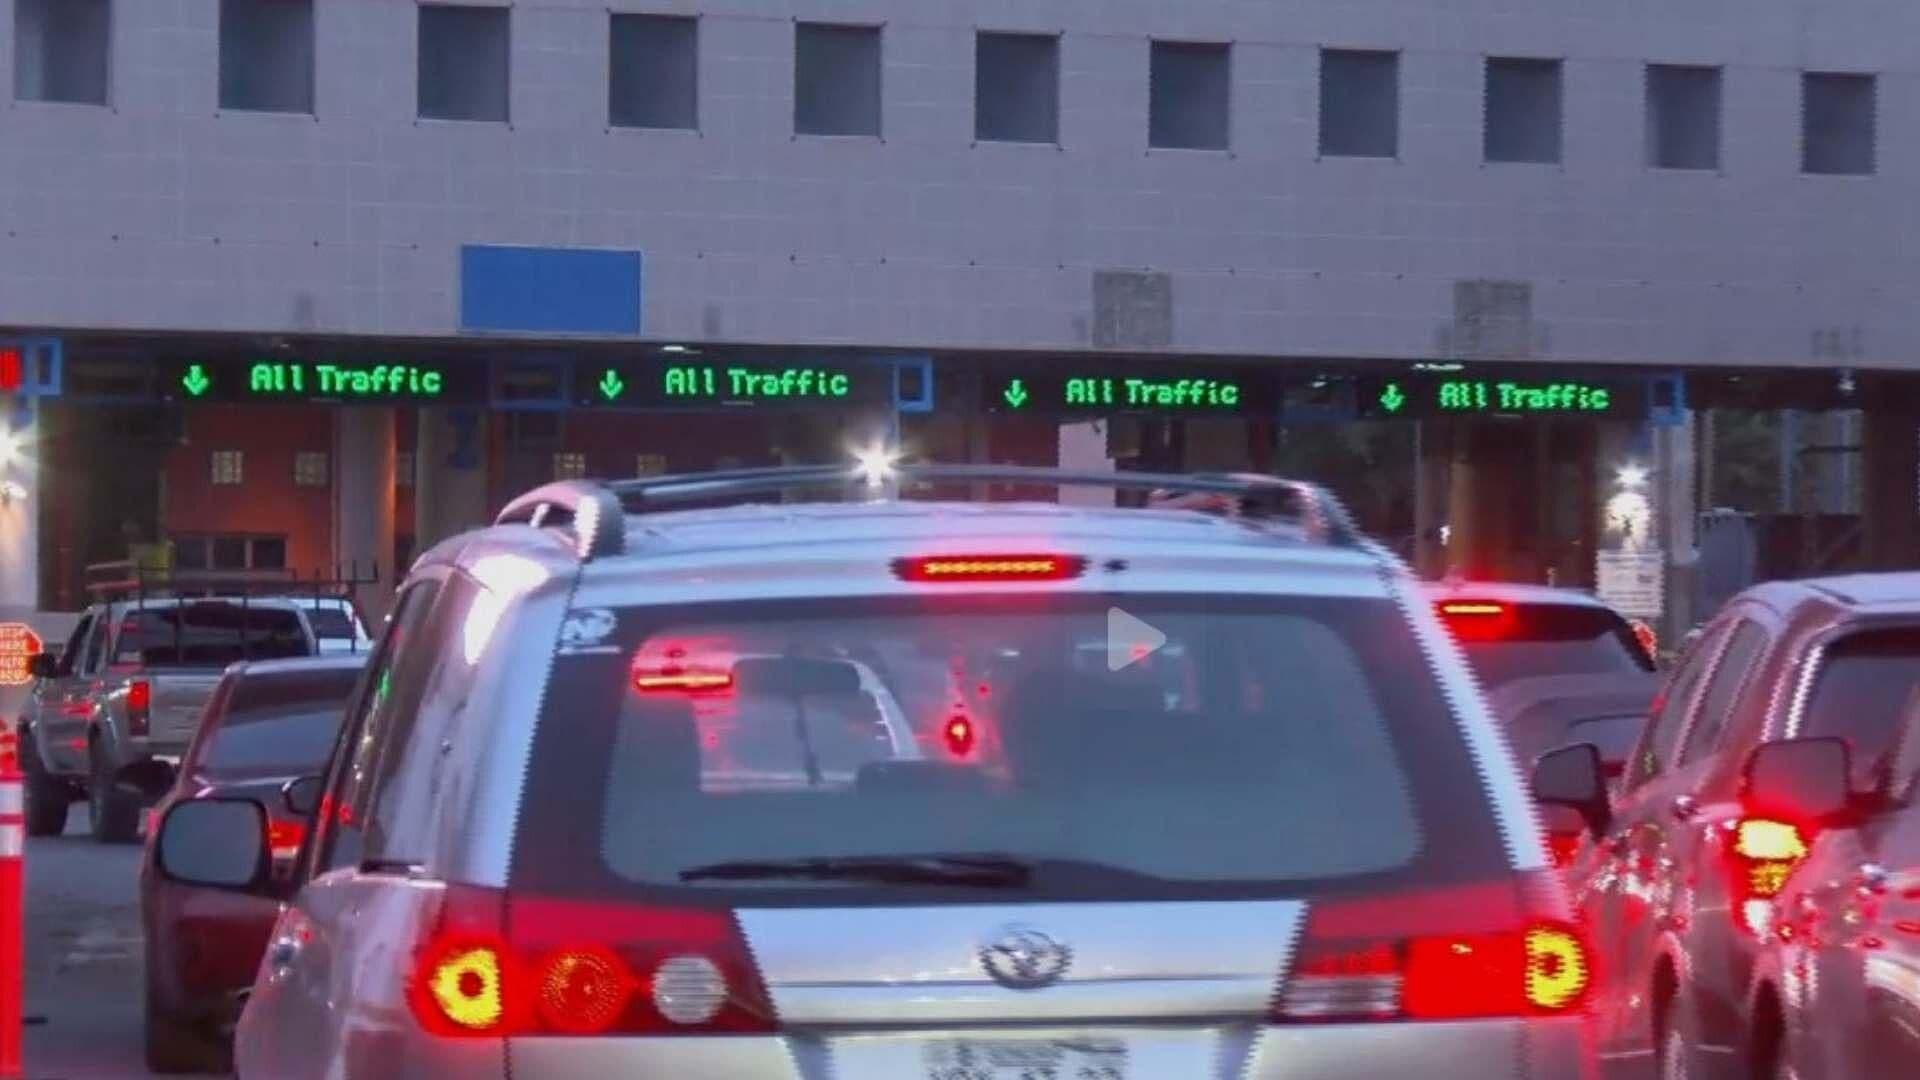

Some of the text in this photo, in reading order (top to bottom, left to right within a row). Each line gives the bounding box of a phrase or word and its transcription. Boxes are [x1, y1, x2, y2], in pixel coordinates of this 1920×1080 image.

[250, 362, 442, 393] All Traffic
[665, 367, 849, 396] All Traffic
[1065, 379, 1239, 404] All Traffic
[1439, 381, 1610, 409] All Traffic
